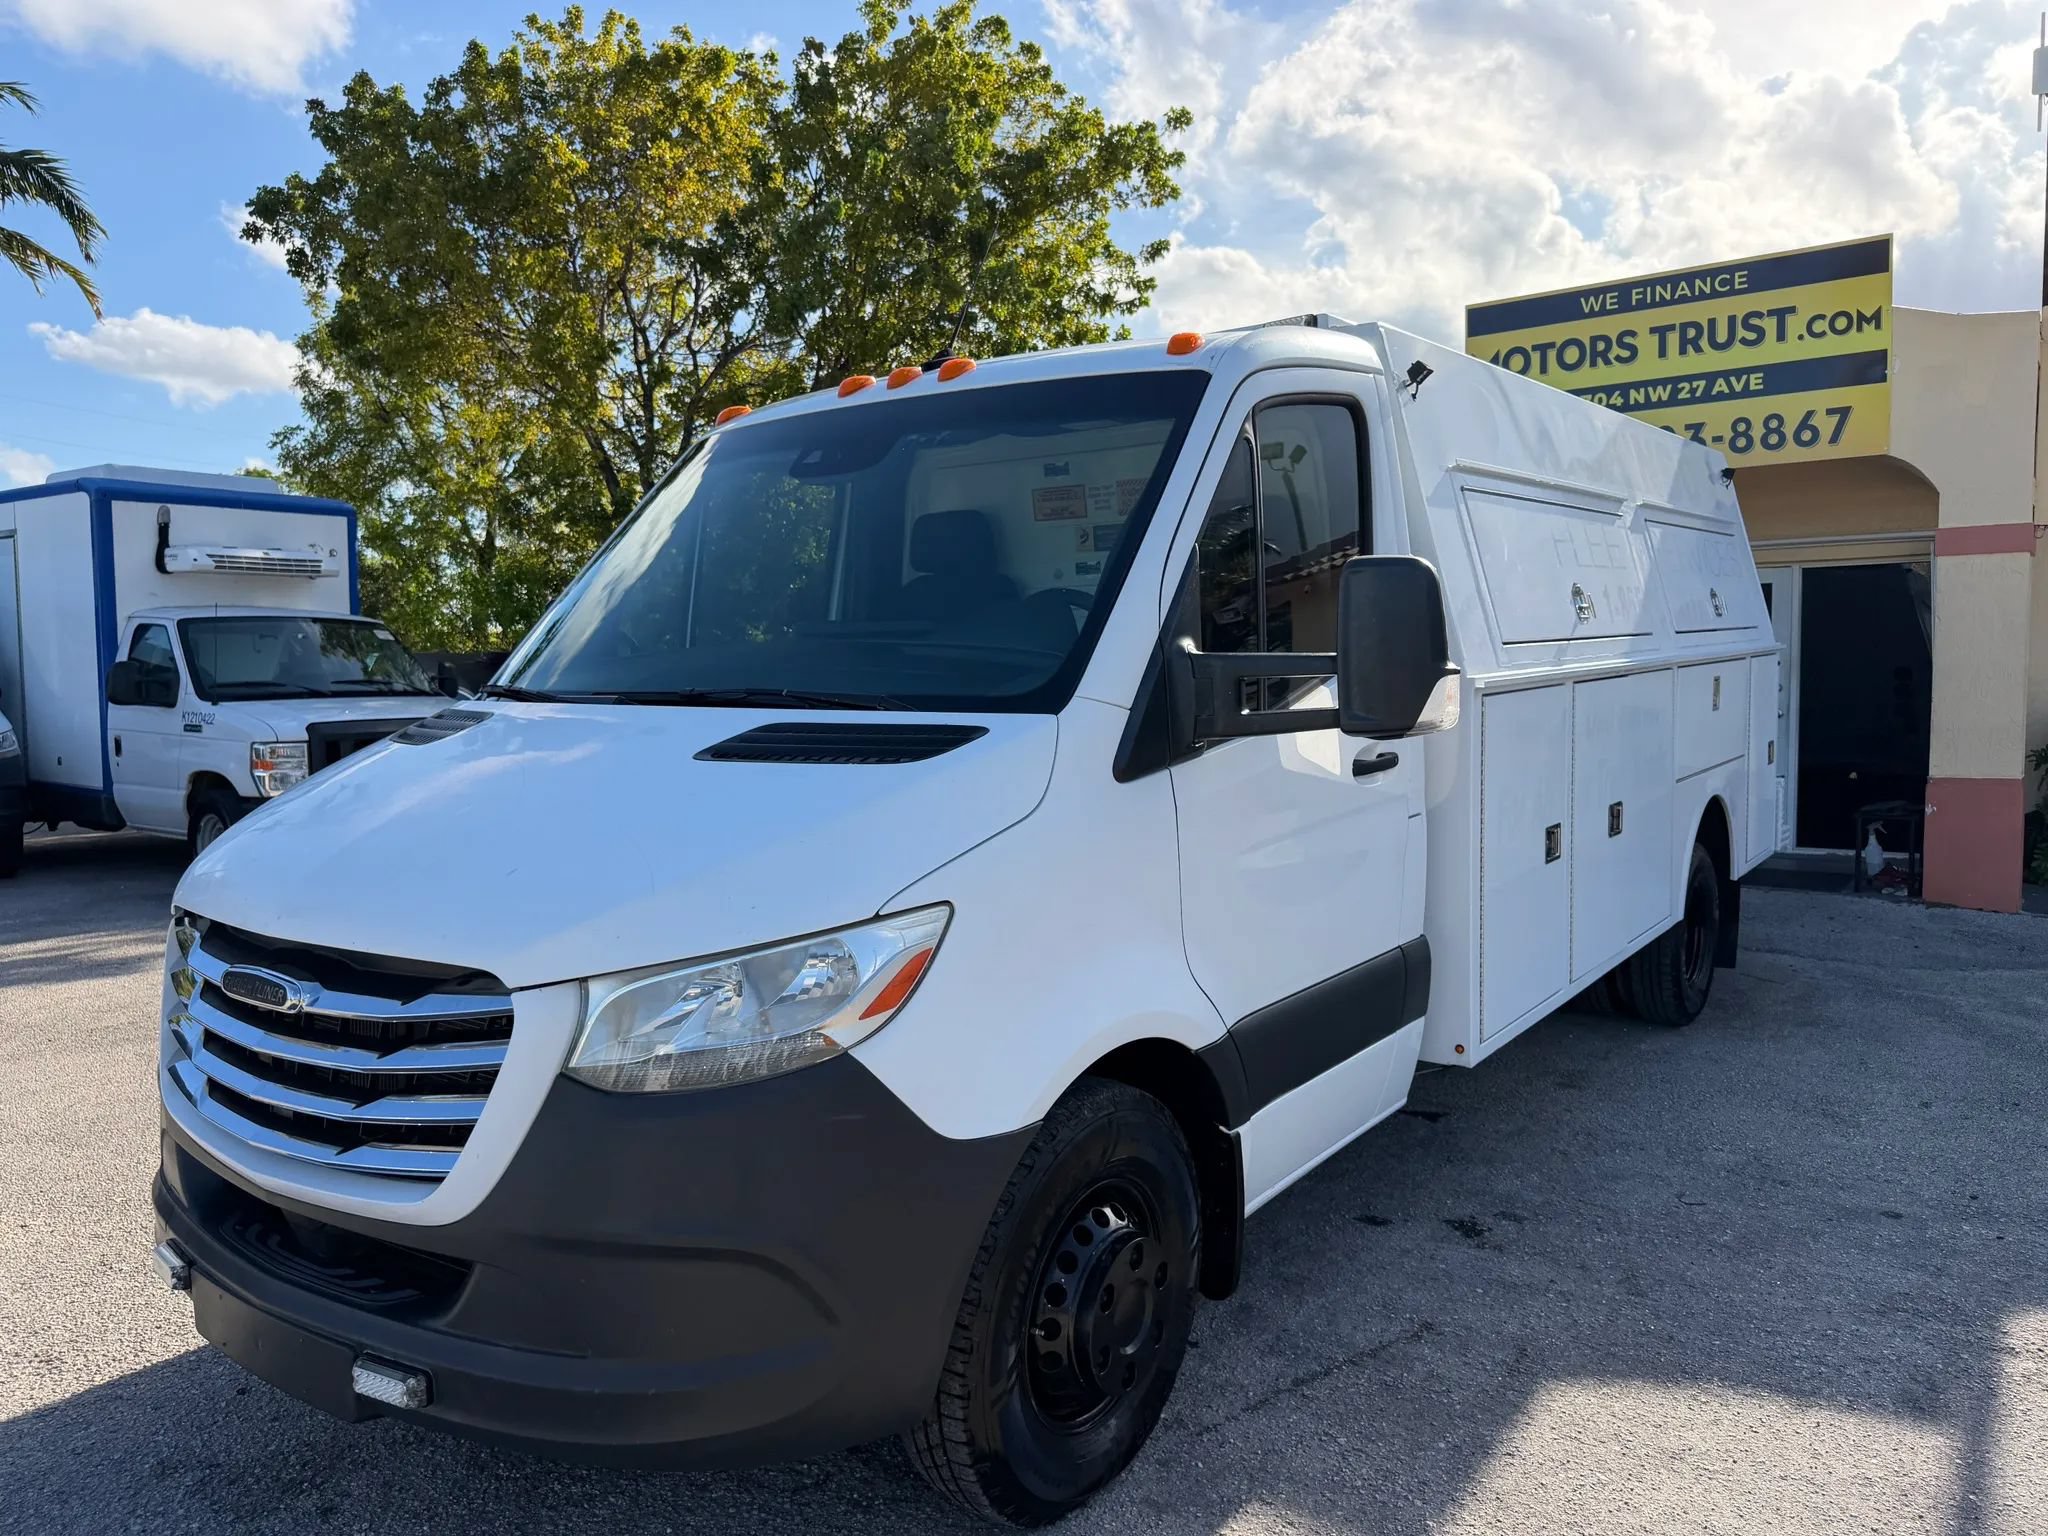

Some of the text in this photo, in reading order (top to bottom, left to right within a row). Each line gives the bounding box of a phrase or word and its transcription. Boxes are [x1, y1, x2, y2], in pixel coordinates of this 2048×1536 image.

[1580, 270, 1749, 313] WE FINANCE
[1649, 305, 1883, 360] TRUST.COM
[1629, 384, 1673, 406] NW
[1678, 379, 1707, 399] 27
[1711, 372, 1764, 395] AVE
[1658, 405, 1854, 456] 3-8867
[182, 710, 216, 725] K1210422
